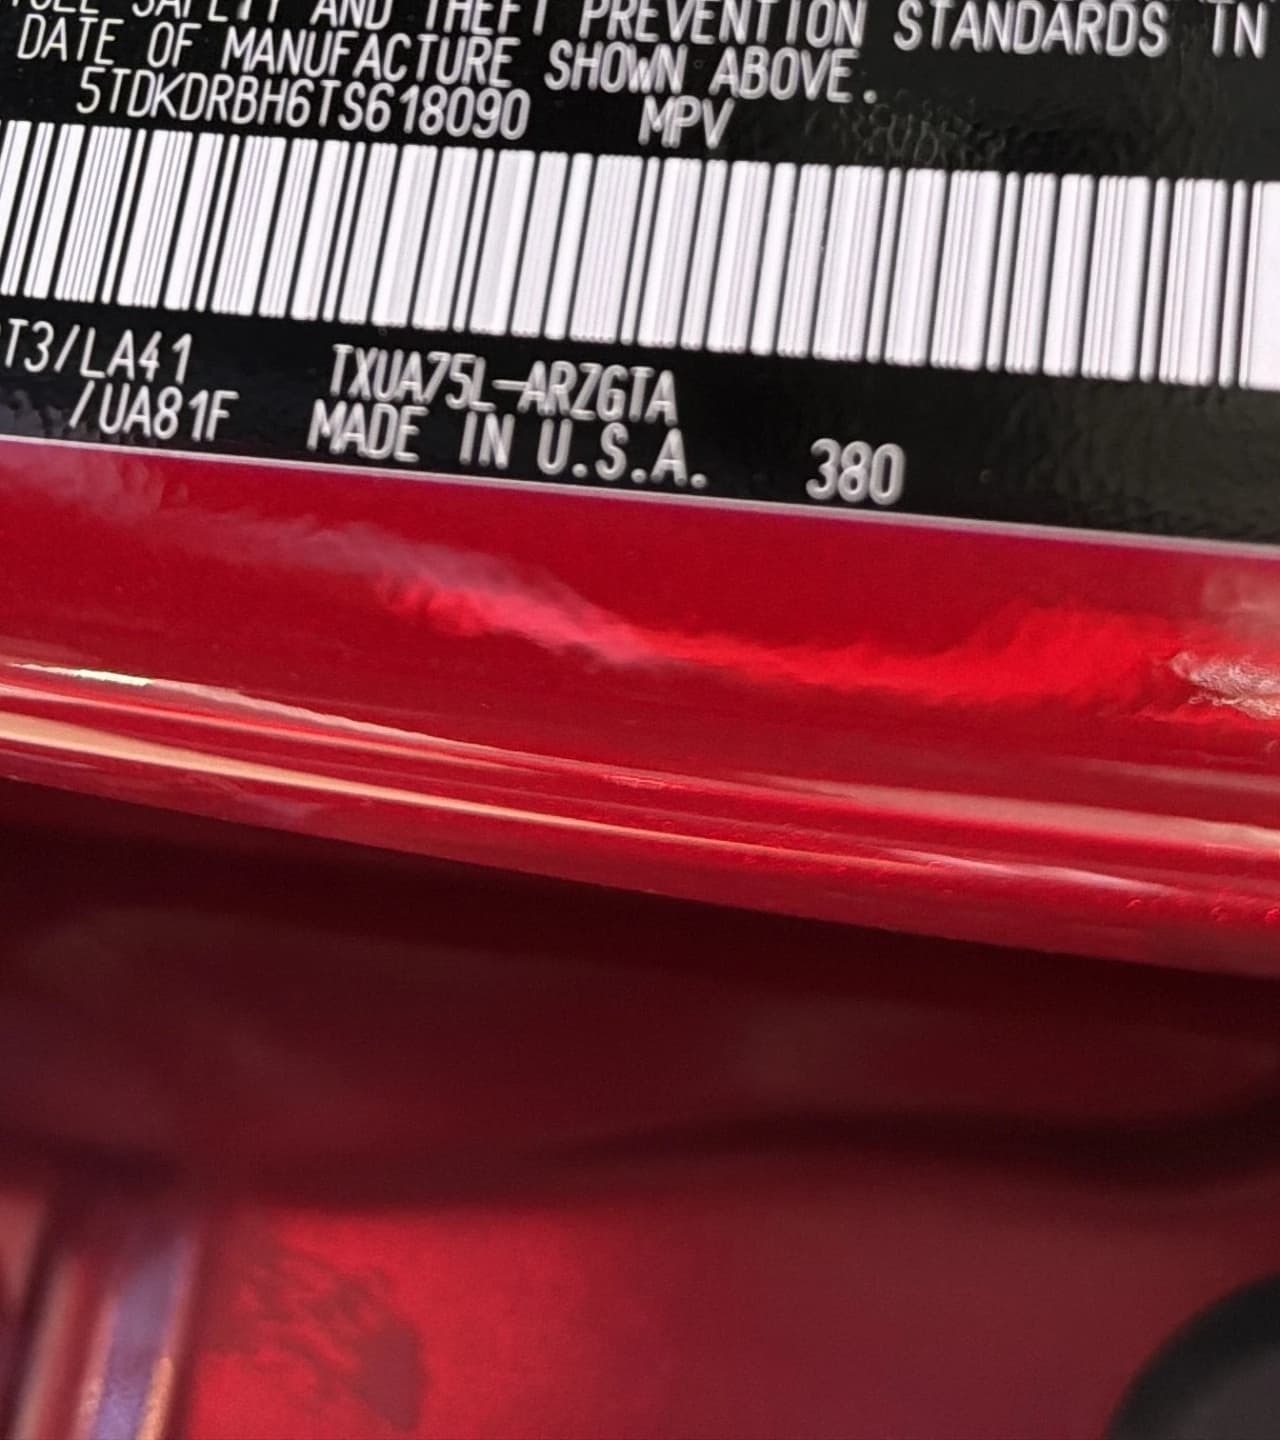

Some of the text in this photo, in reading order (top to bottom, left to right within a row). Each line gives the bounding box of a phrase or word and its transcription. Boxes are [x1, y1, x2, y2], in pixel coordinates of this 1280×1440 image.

[18, 16, 123, 66] DATE
[147, 21, 202, 69] OF
[221, 25, 521, 88] MANUFACTURE
[544, 40, 687, 94] SHOWN
[708, 45, 878, 104] ABOVE.
[1211, 2, 1268, 58] IN
[76, 68, 736, 150] 5TDKDRBH6TS618090 MPV
[330, 343, 679, 426] TXUA75L-ARZGTA
[69, 380, 239, 441] /UA81F
[307, 398, 429, 462] MADE
[459, 411, 515, 469] IN
[537, 419, 708, 489] U.S.A.
[806, 437, 905, 505] 380
